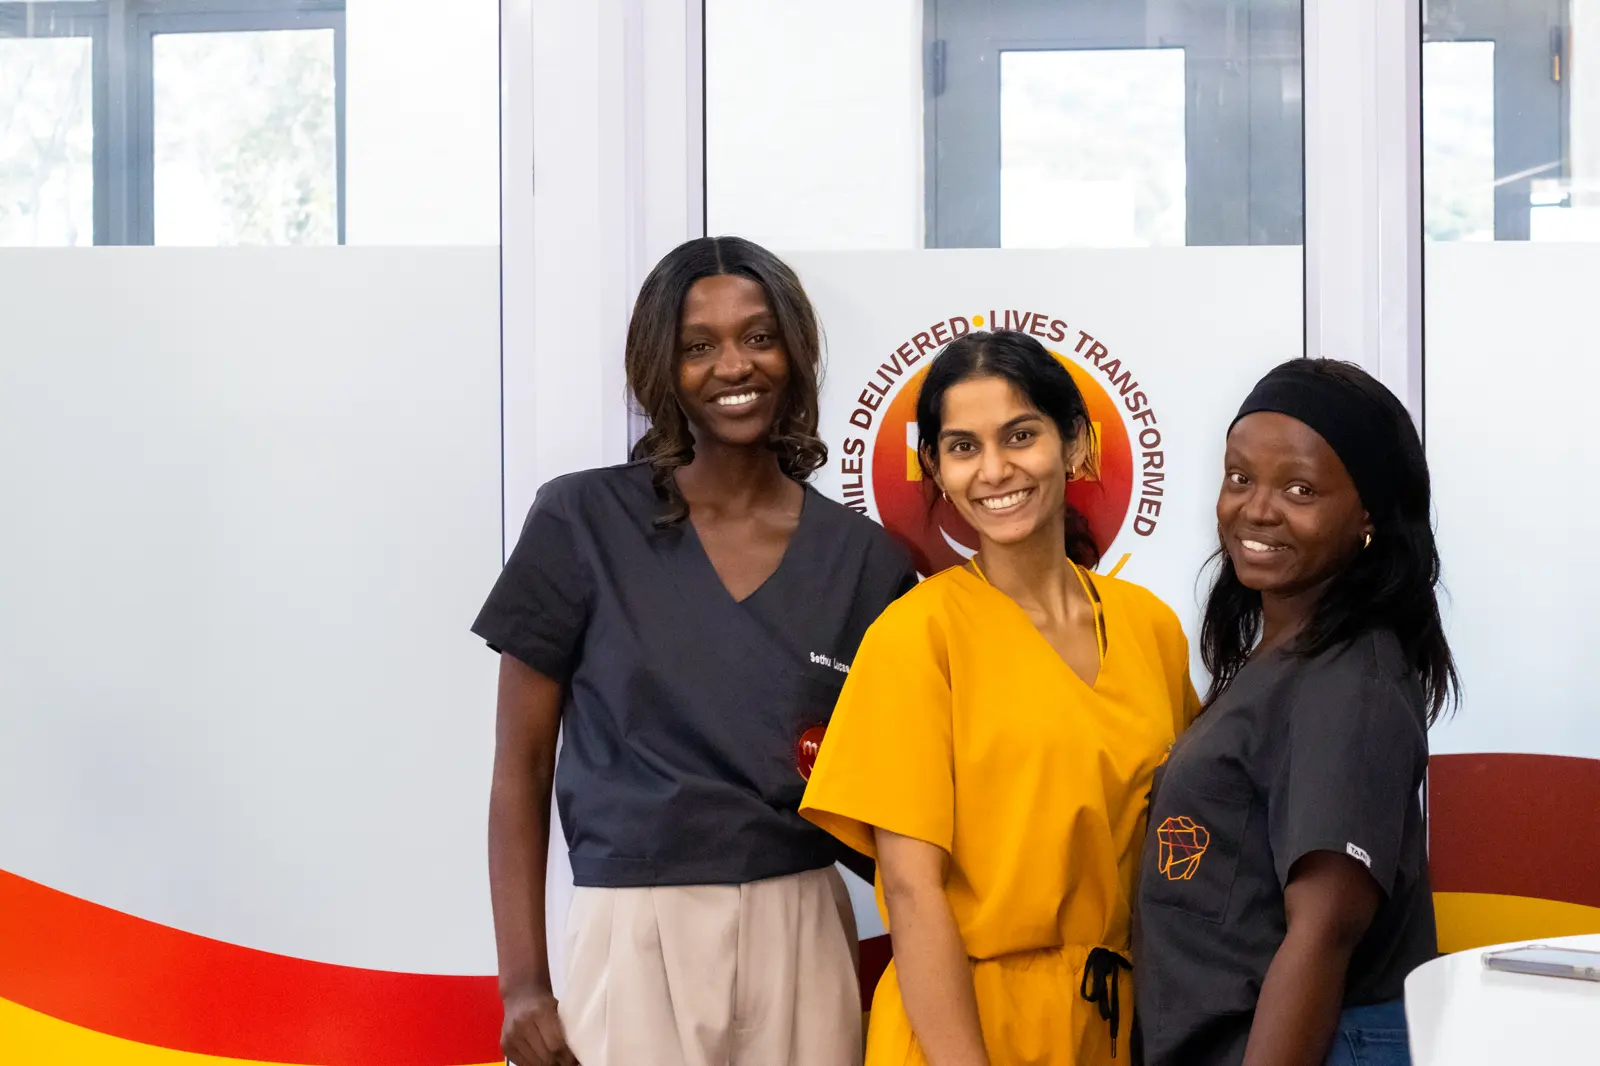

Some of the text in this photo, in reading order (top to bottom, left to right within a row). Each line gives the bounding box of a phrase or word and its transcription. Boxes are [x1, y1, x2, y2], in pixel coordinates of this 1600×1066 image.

[849, 316, 970, 430] DELIVERED
[989, 309, 1068, 343] LIVES
[1074, 330, 1165, 537] TRANSFORMED
[809, 651, 832, 667] Sethu
